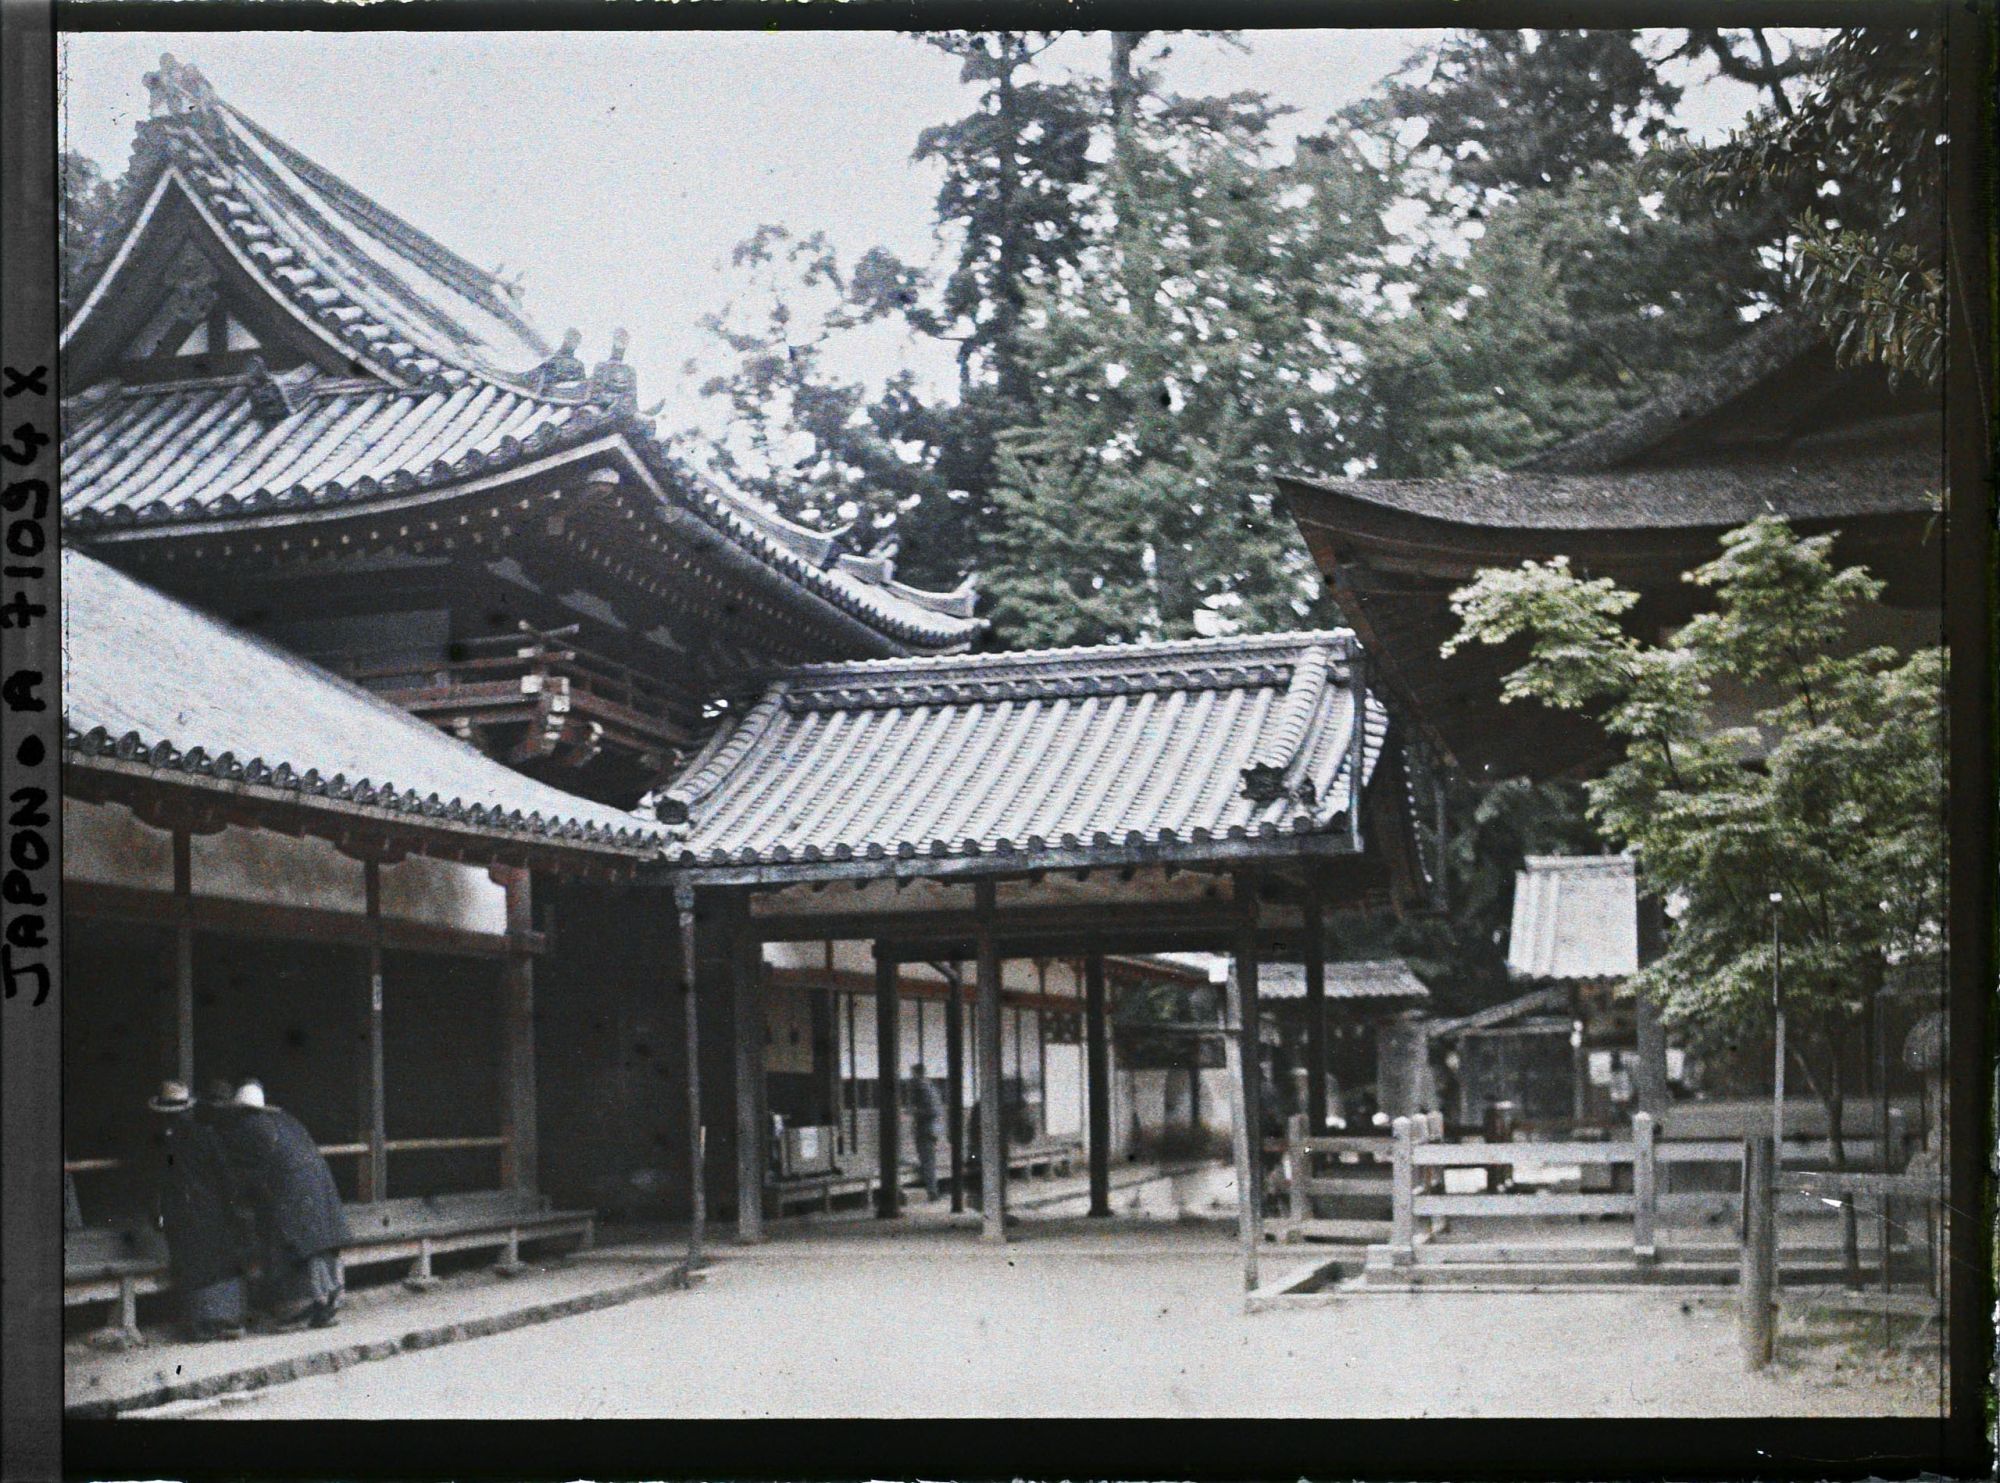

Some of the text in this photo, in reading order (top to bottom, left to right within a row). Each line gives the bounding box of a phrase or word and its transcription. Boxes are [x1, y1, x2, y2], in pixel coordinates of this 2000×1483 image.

[0, 422, 50, 629] 71094
[3, 669, 46, 713] A
[2, 786, 50, 1006] JAPON
